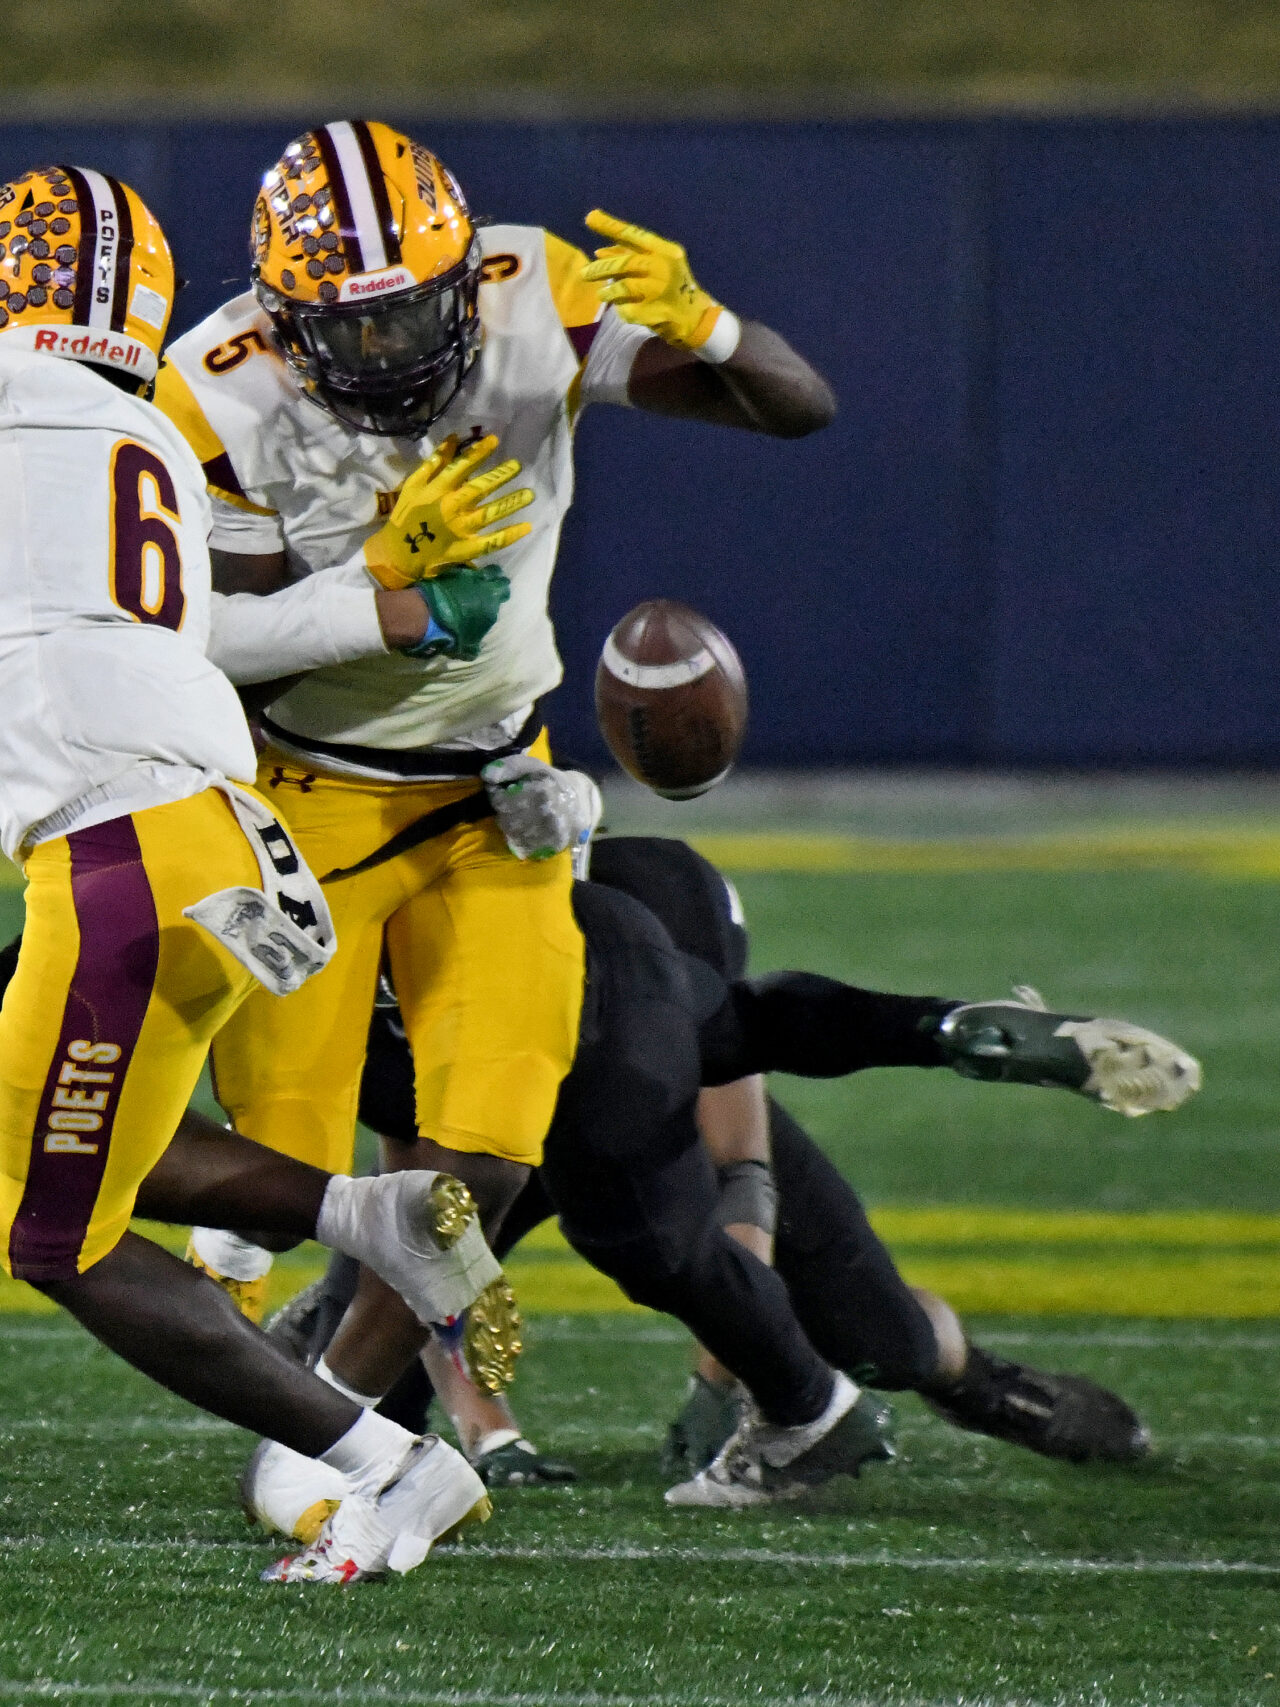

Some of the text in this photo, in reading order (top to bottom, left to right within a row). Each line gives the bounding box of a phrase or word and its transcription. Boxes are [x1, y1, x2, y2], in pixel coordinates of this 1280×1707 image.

[96, 209, 115, 304] POETS
[349, 274, 405, 294] Riddell
[34, 329, 141, 366] Riddell
[202, 329, 267, 376] 5
[108, 437, 187, 634] 6
[43, 1039, 123, 1155] POETS
